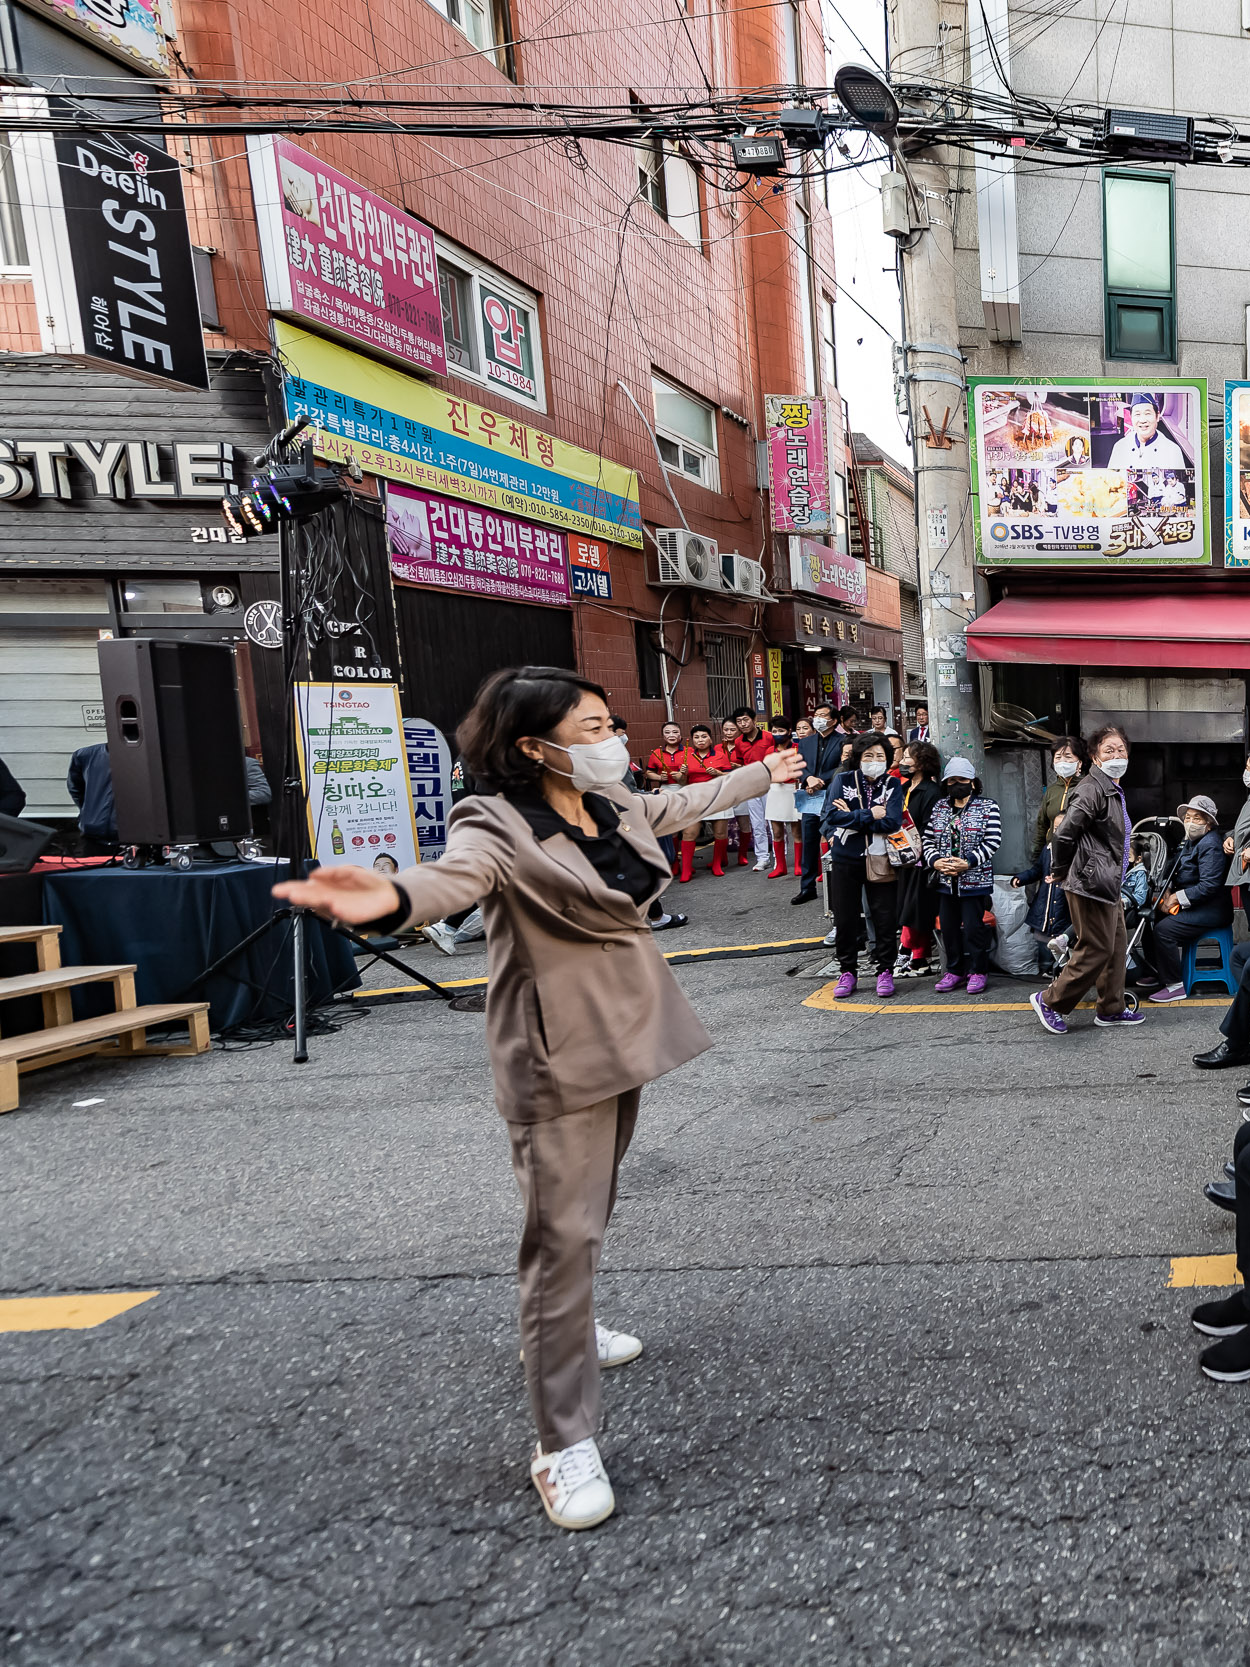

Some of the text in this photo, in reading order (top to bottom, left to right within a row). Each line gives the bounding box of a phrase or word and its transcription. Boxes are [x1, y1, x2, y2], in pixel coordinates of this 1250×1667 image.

[76, 146, 167, 211] Daejin
[317, 171, 438, 297] 건대동안피부관리
[101, 198, 174, 372] STYLE
[90, 295, 115, 352] 헤어샵
[484, 296, 525, 370] 압
[447, 396, 555, 468] 진우체형
[780, 403, 812, 525] 짱노래연습장
[429, 500, 563, 566] 건대동안피부관리
[577, 542, 601, 568] 로뎀
[520, 563, 565, 585] 070-8221-7688
[574, 571, 609, 597] 고시텔
[810, 553, 862, 595] 짱노래연습장
[333, 665, 393, 679] COLOR
[325, 800, 398, 817] 함께 갑니다!
